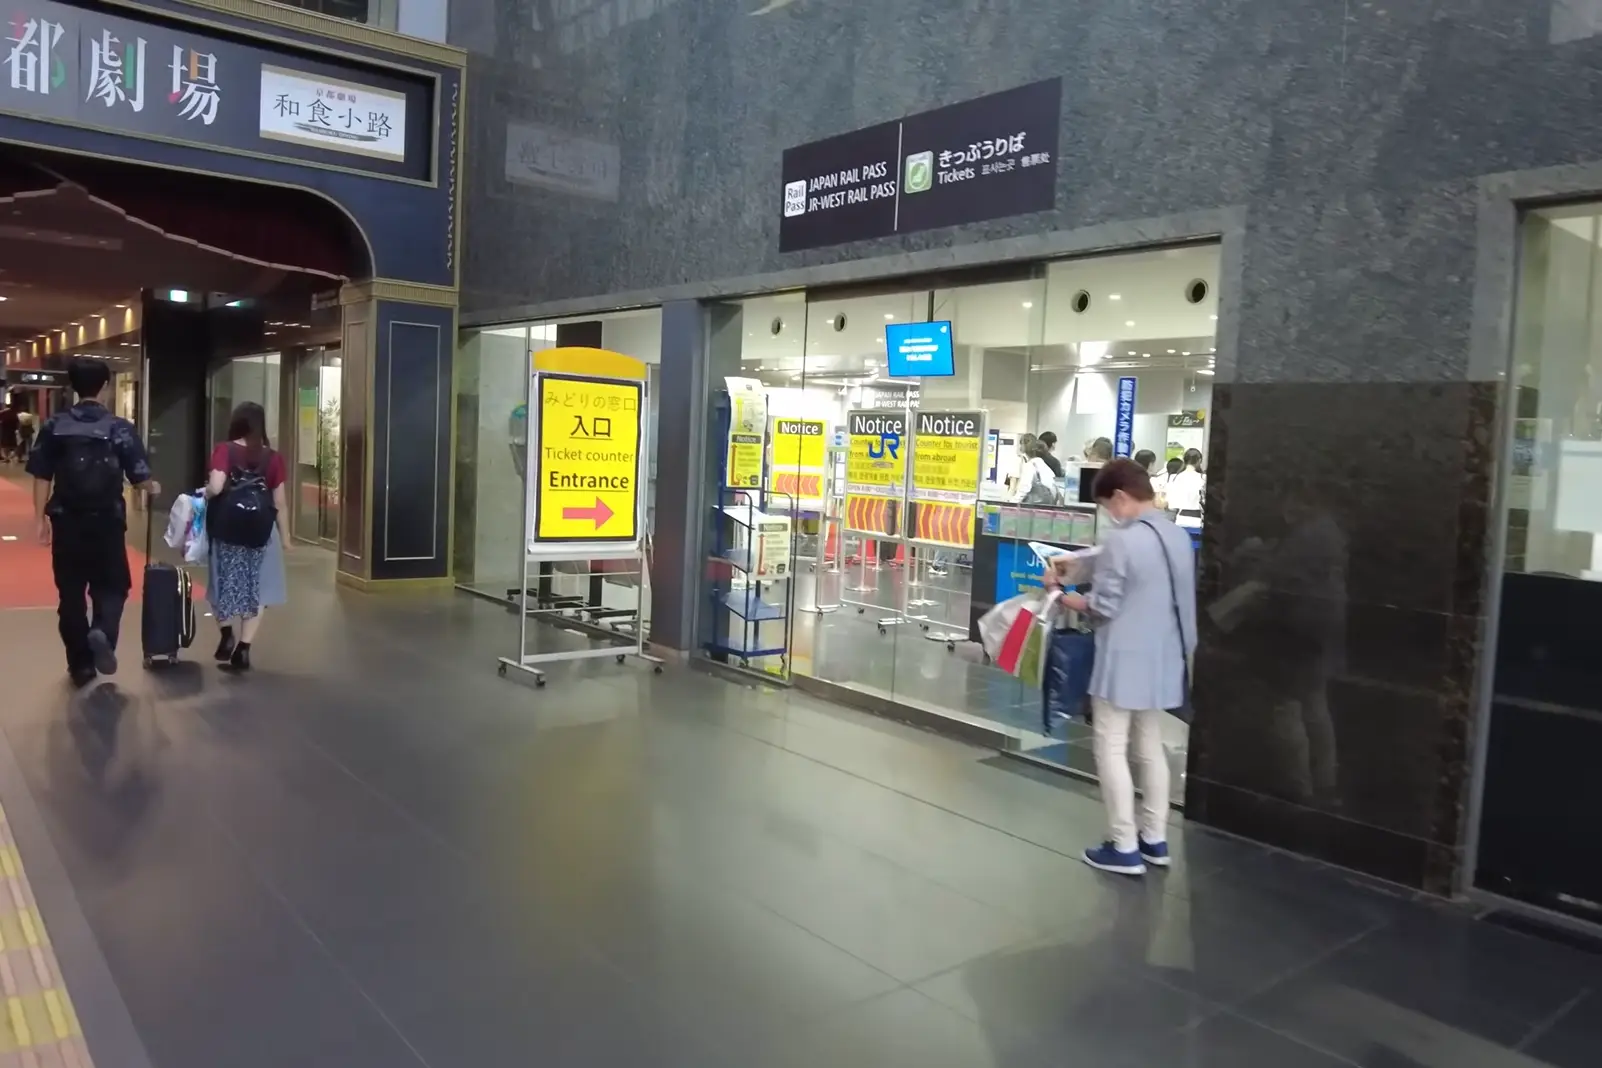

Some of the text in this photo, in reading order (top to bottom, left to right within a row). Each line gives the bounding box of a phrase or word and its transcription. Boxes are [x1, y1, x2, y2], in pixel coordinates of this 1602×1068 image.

[2, 17, 221, 126] 都劇場
[273, 93, 393, 138] 和食小路
[938, 131, 1027, 168] きっぷうりば
[808, 161, 888, 193] JAPAN RAIL PASS
[937, 167, 976, 184] Tickets
[787, 184, 805, 200] Rail
[807, 180, 897, 213] JR-WEST RAIL PASS
[785, 201, 806, 213] Pass
[545, 391, 636, 411] みどりの窓口
[570, 415, 612, 437] 入口
[781, 421, 819, 435] Notice
[855, 414, 903, 435] Notice
[921, 413, 975, 436] Notice
[545, 446, 634, 463] Ticket counter
[550, 470, 630, 489] Entrance
